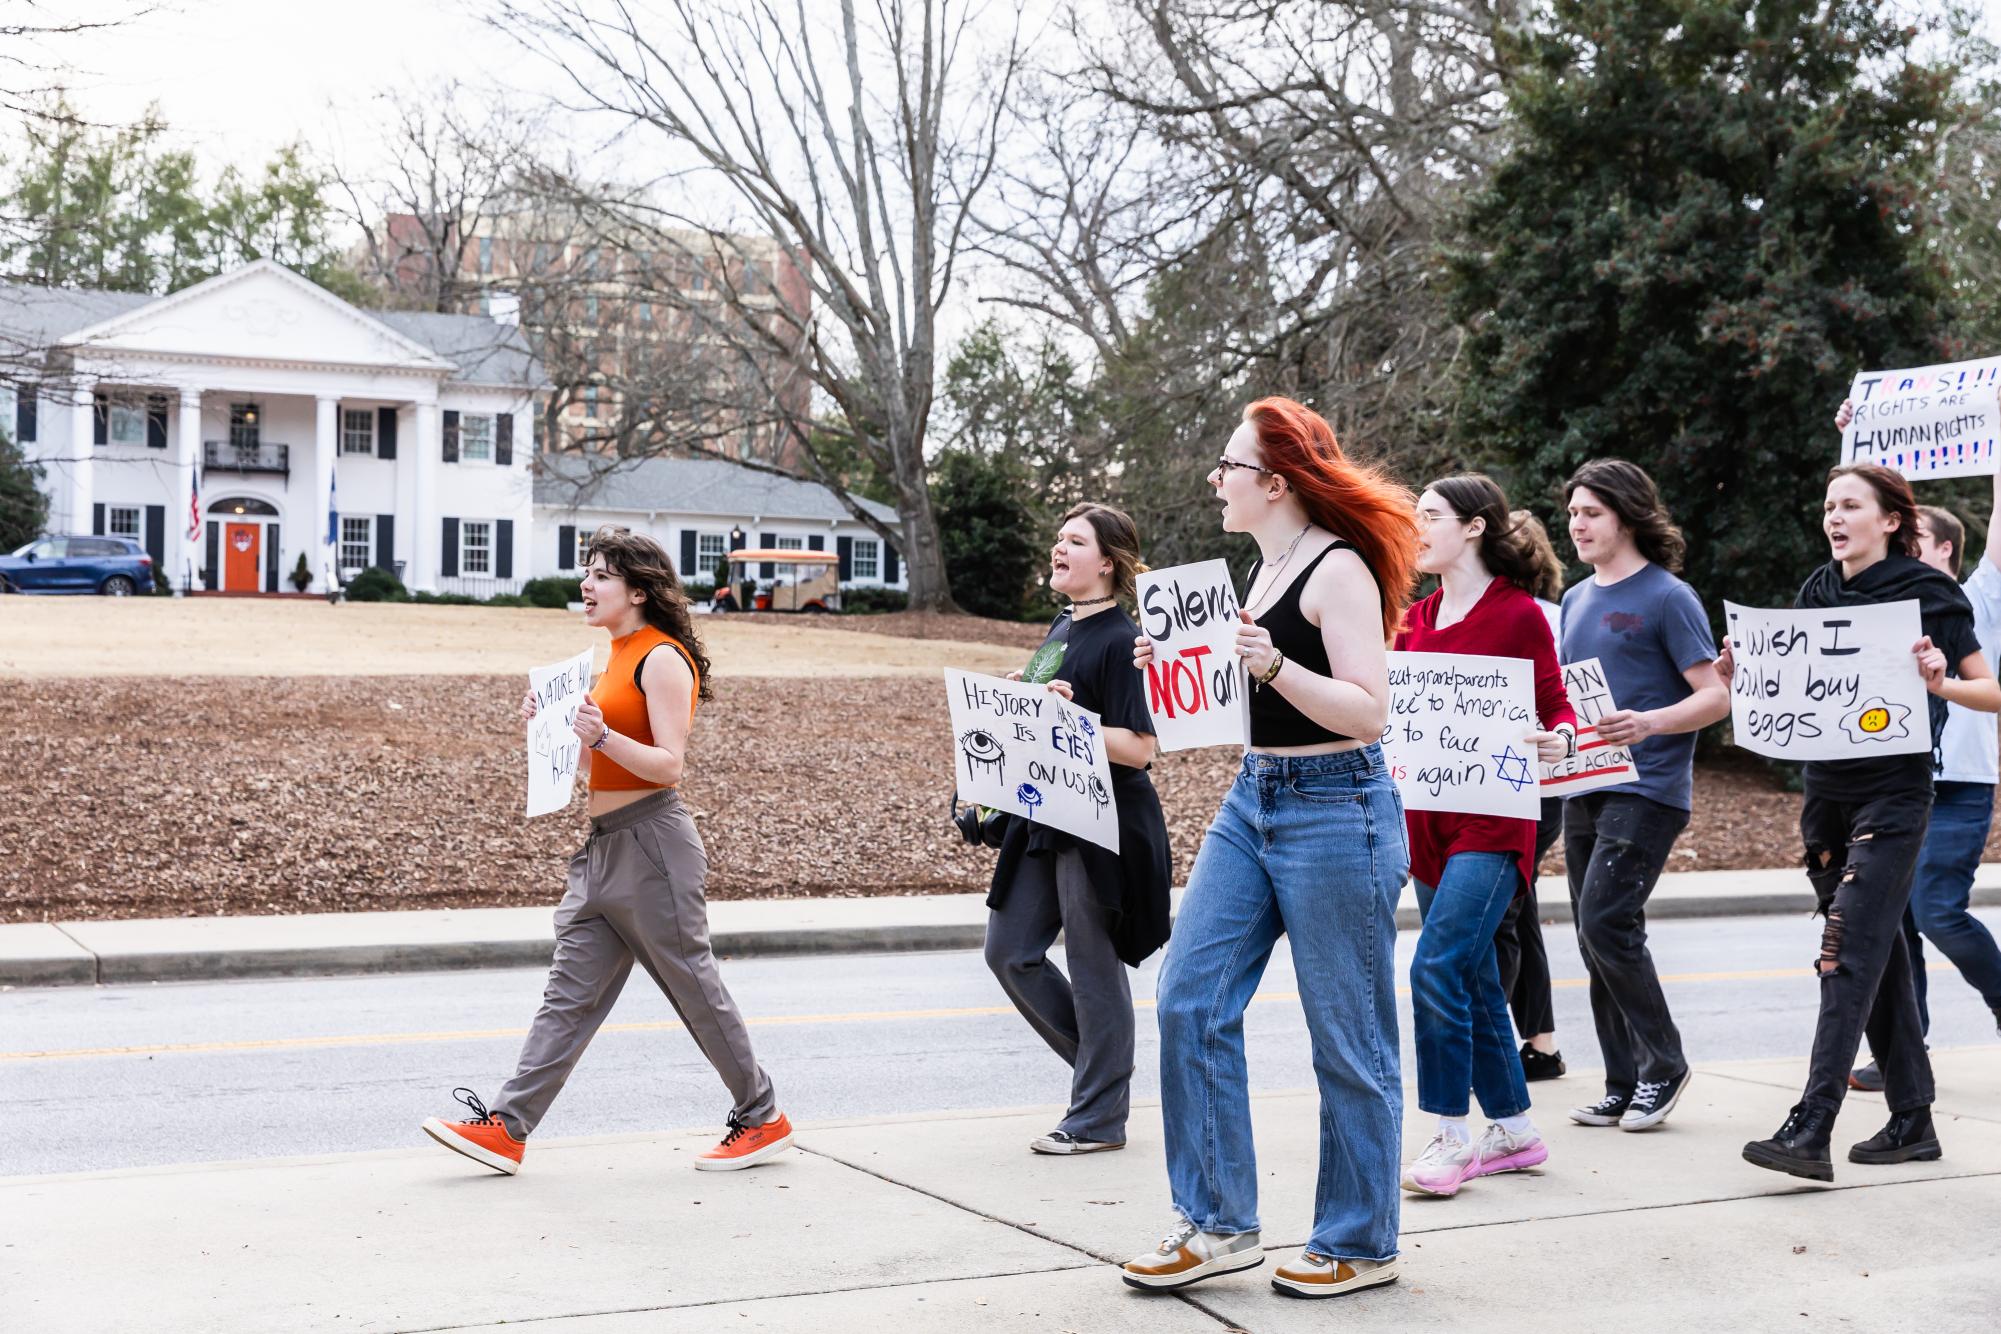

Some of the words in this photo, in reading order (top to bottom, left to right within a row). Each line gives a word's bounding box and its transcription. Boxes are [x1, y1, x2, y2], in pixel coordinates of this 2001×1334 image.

[1854, 396, 1931, 425] RIGHTS
[1939, 393, 1970, 407] ARE
[1852, 424, 1931, 461] HUMAN
[1935, 414, 1986, 446] RIGHTS
[1729, 613, 1741, 649] I
[1819, 620, 1861, 656] I
[537, 666, 575, 713] NATURE
[1147, 645, 1213, 720] NOT
[1804, 664, 1861, 708] buy
[962, 677, 1043, 718] HISTORY
[1055, 699, 1077, 733] HAS
[1428, 692, 1445, 712] to
[1453, 690, 1529, 723] America
[1051, 725, 1094, 766] EYES
[1402, 720, 1424, 743] to
[1439, 725, 1480, 753] face
[1748, 709, 1823, 747] eggs
[1028, 760, 1057, 785] ON
[1063, 767, 1086, 795] US
[1416, 760, 1486, 798] again
[1584, 750, 1633, 772] ACTION
